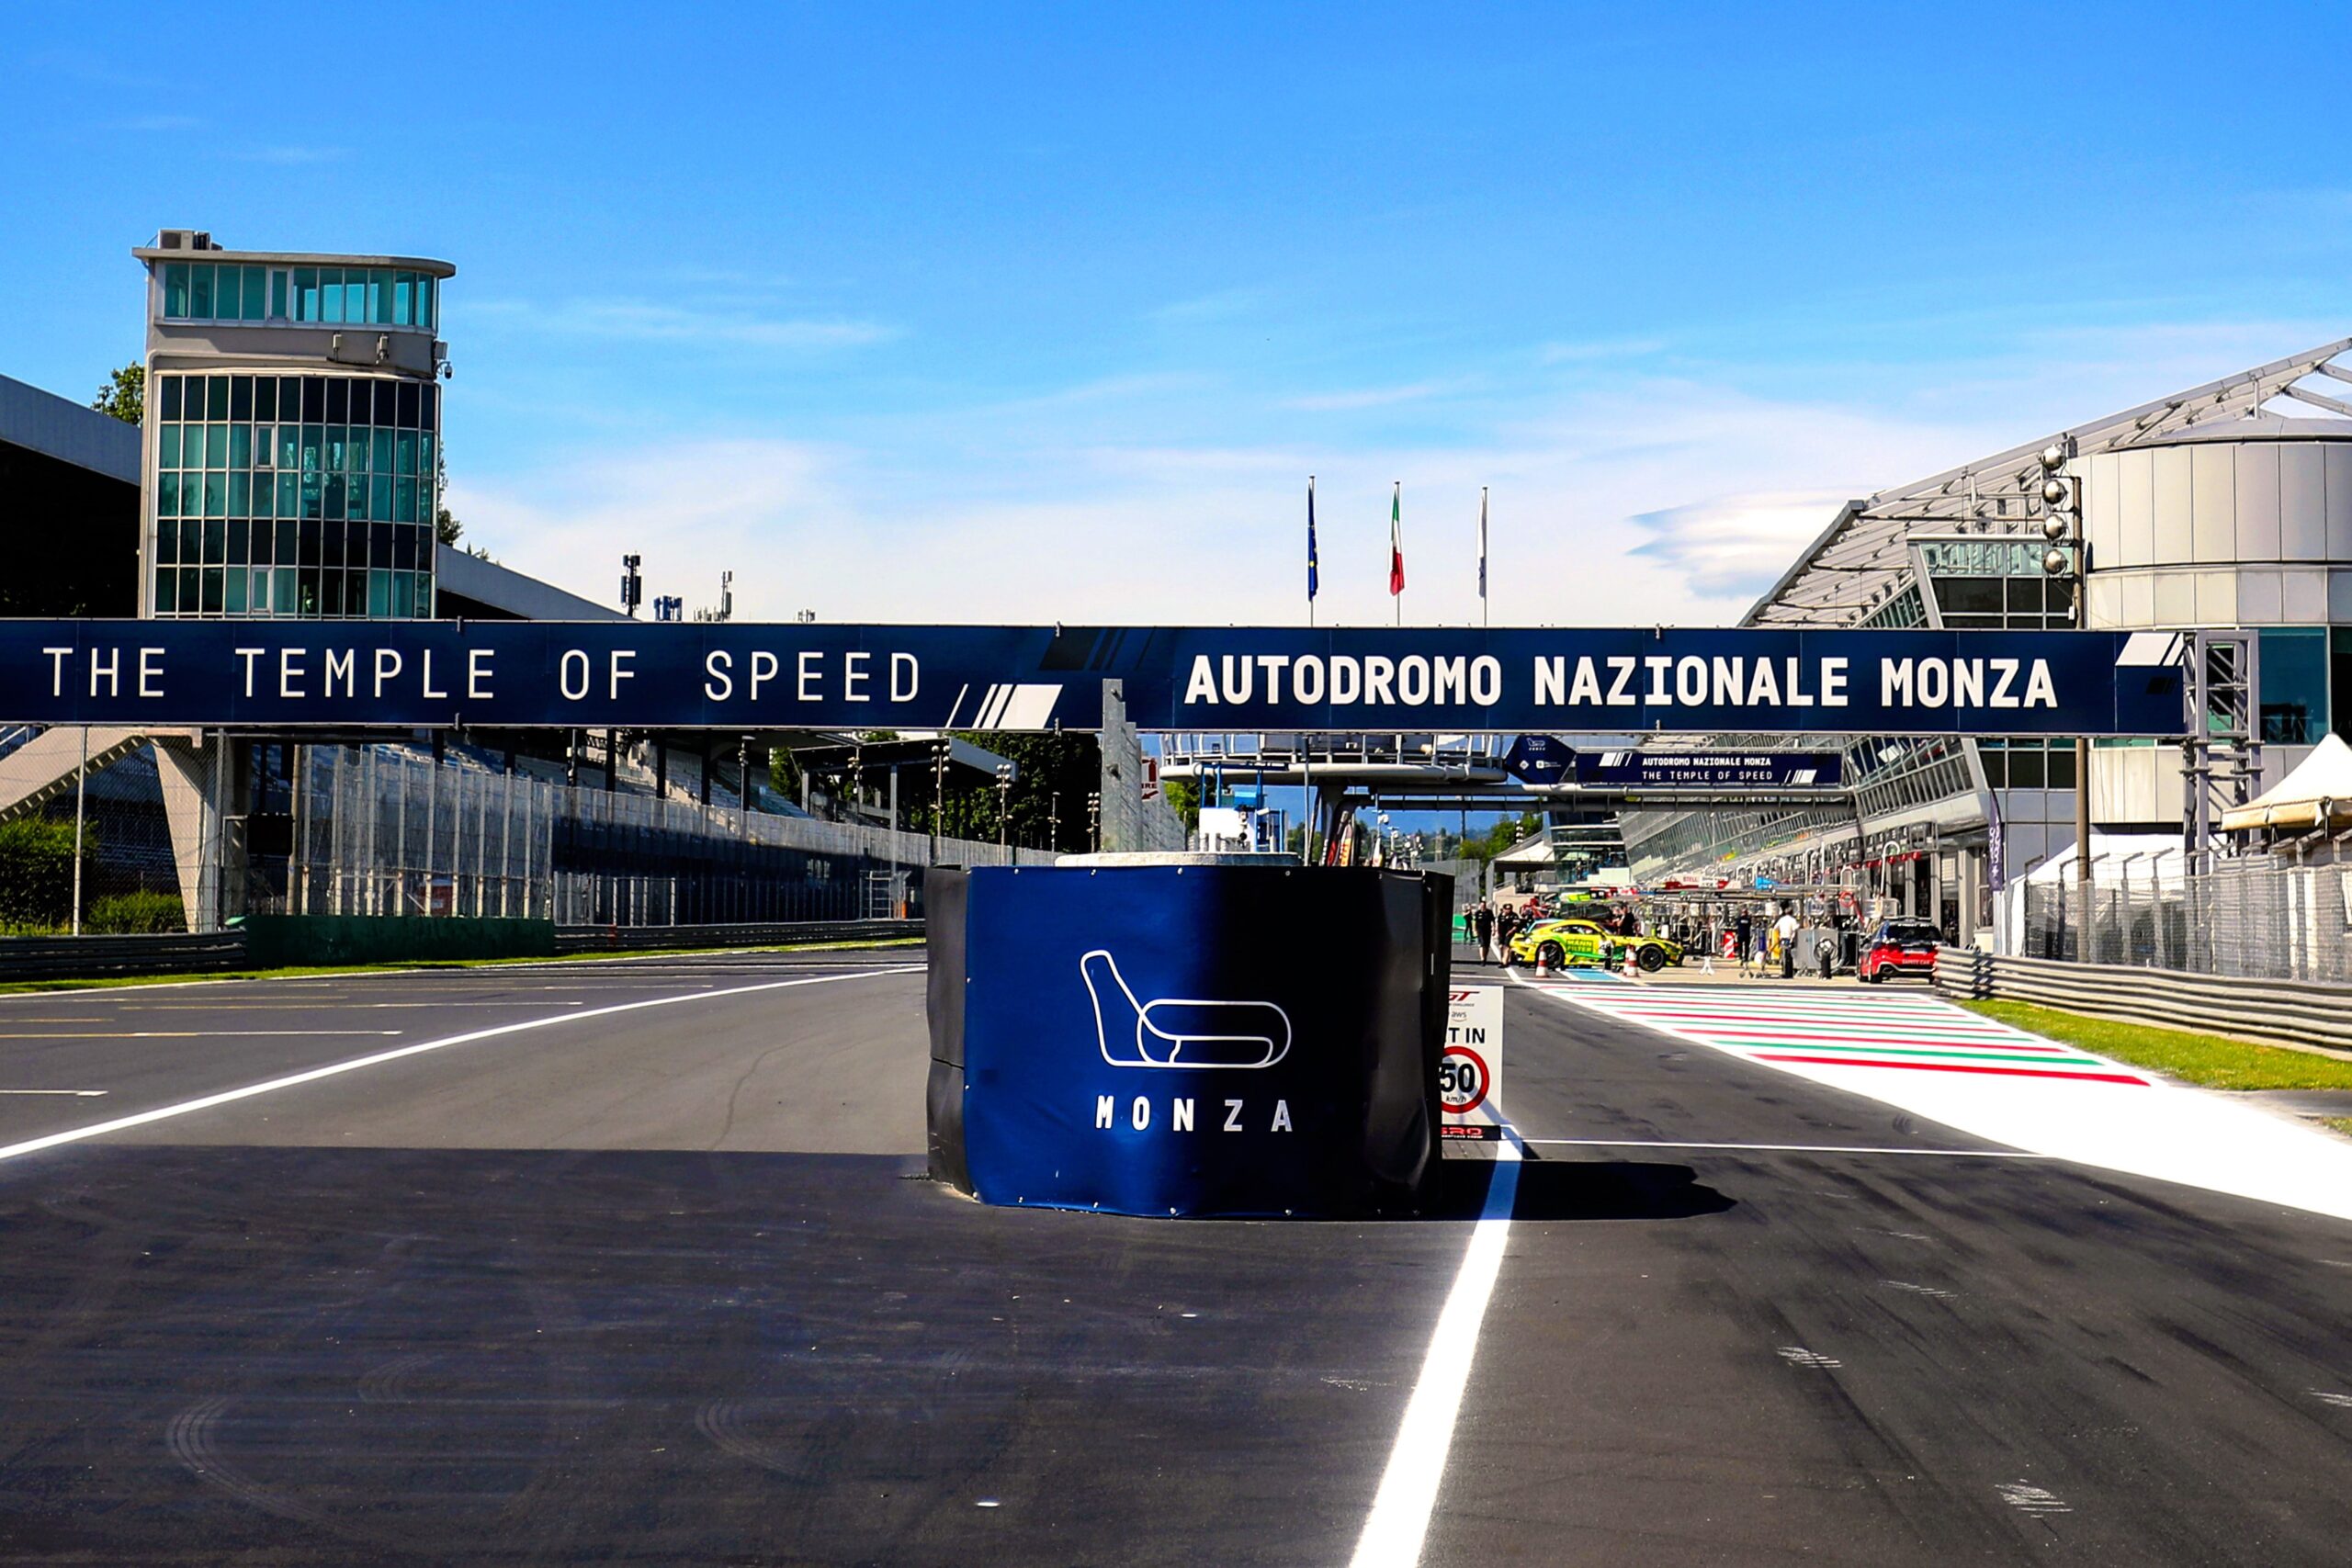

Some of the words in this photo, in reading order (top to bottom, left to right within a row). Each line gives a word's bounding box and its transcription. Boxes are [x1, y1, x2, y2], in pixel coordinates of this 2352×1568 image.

[42, 647, 165, 698] THE
[234, 648, 494, 699] TEMPLE
[560, 649, 636, 700] OF
[705, 650, 919, 702] SPEED
[1183, 654, 1502, 706] AUTODROMO
[1534, 655, 1849, 706] NAZIONALE
[1881, 657, 2058, 708] MONZA
[1642, 757, 1690, 766] AUTODROMO
[1692, 757, 1741, 766] NAZIONALE
[1744, 757, 1771, 766] MONZA
[1642, 771, 1661, 780] THE
[1669, 771, 1710, 780] TEMPLE
[1717, 771, 1731, 780] OF
[1738, 771, 1773, 780] SPEED
[1445, 1027, 1460, 1043] T
[1465, 1027, 1486, 1044] IN
[1439, 1063, 1476, 1093] 50
[1445, 1095, 1467, 1103] km/h
[1095, 1095, 1293, 1133] MONZA
